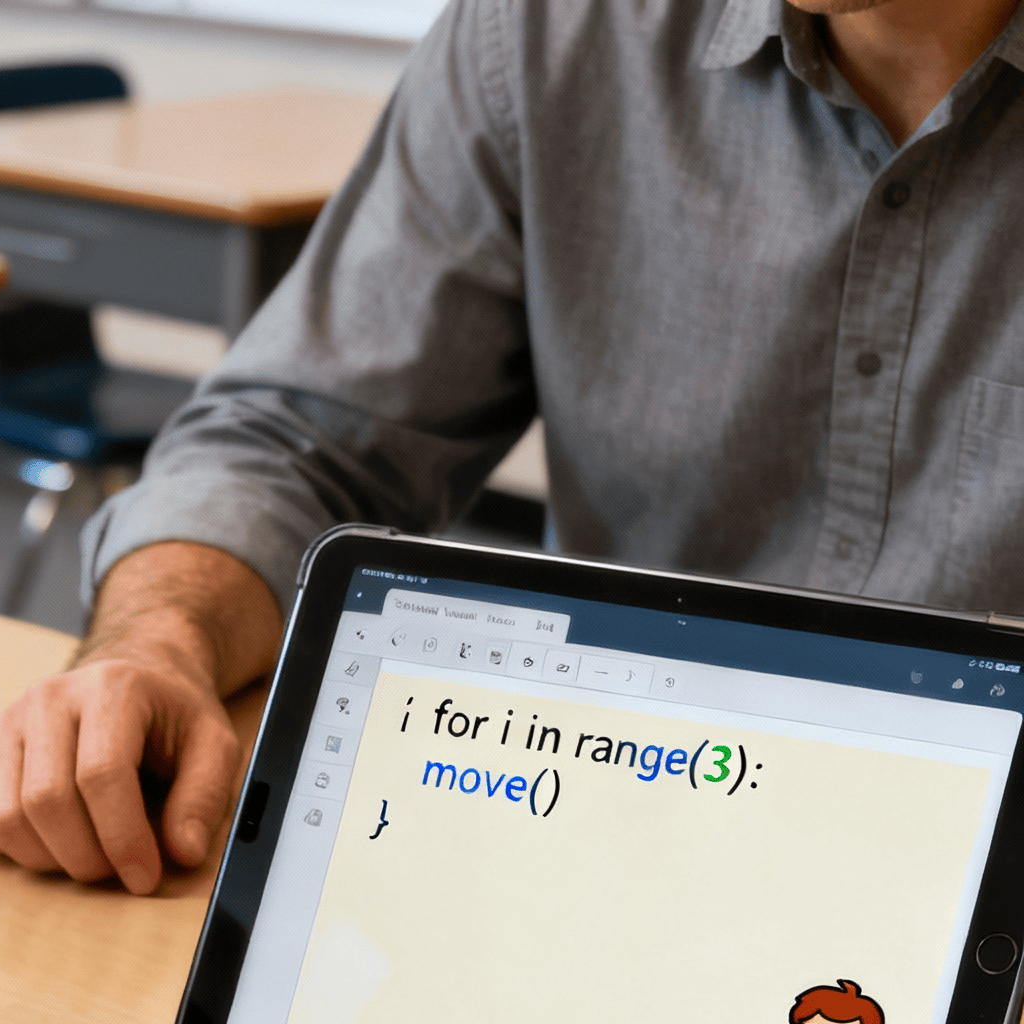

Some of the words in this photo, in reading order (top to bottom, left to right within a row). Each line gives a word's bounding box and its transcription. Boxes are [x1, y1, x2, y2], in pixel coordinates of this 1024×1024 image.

[433, 698, 490, 740] for
[500, 709, 514, 745] i
[525, 714, 561, 754] in
[574, 733, 763, 796] range(3):
[422, 760, 561, 818] move()
